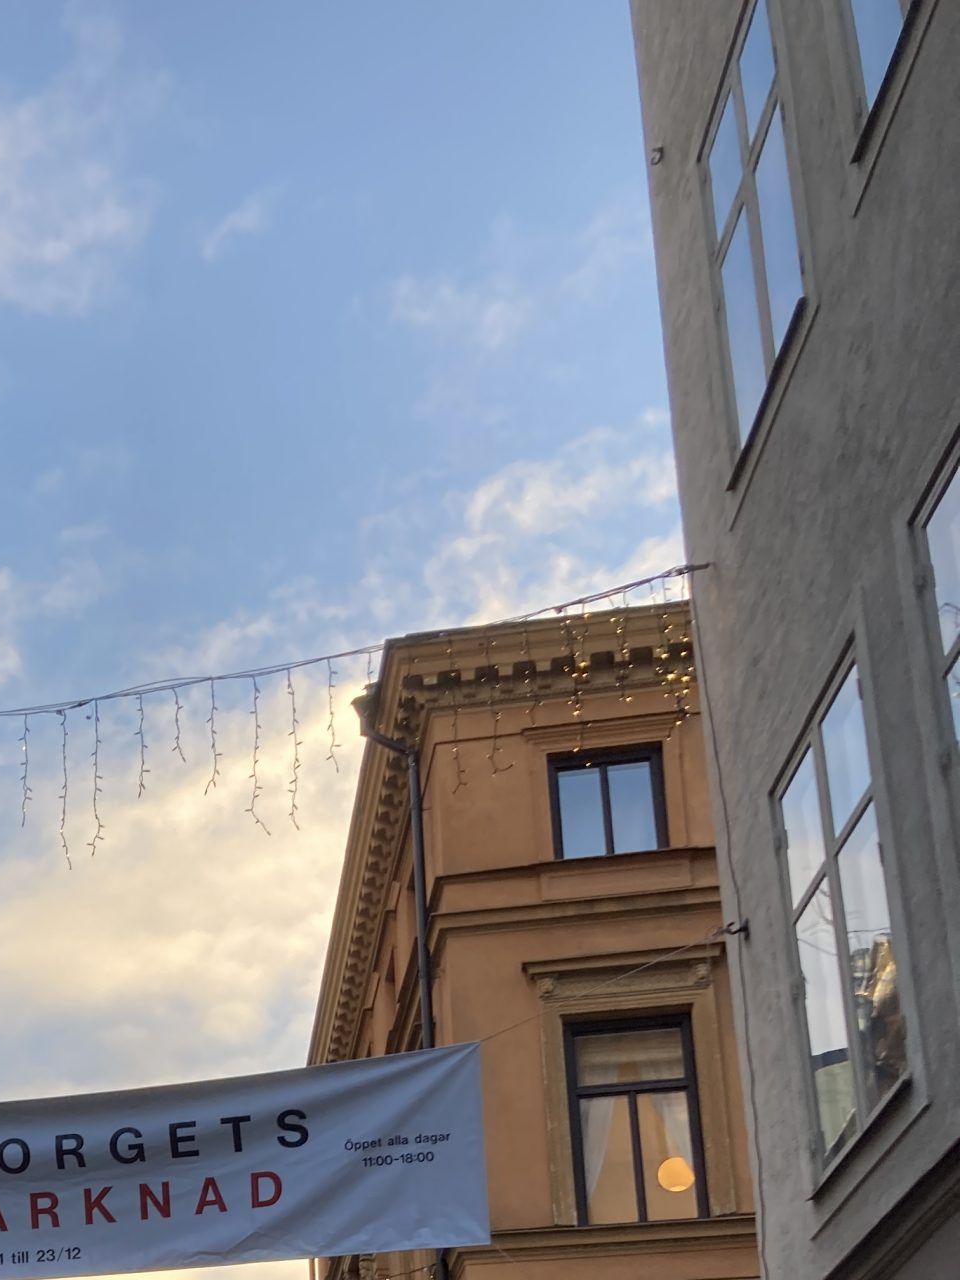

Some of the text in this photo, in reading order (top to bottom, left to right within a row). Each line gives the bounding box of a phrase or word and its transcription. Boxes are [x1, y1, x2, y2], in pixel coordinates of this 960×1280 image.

[344, 1132, 451, 1151] Öppet alla dagar
[362, 1151, 434, 1167] 11:00-18:00
[11, 1251, 29, 1264] till
[36, 1247, 81, 1263] 23/12
